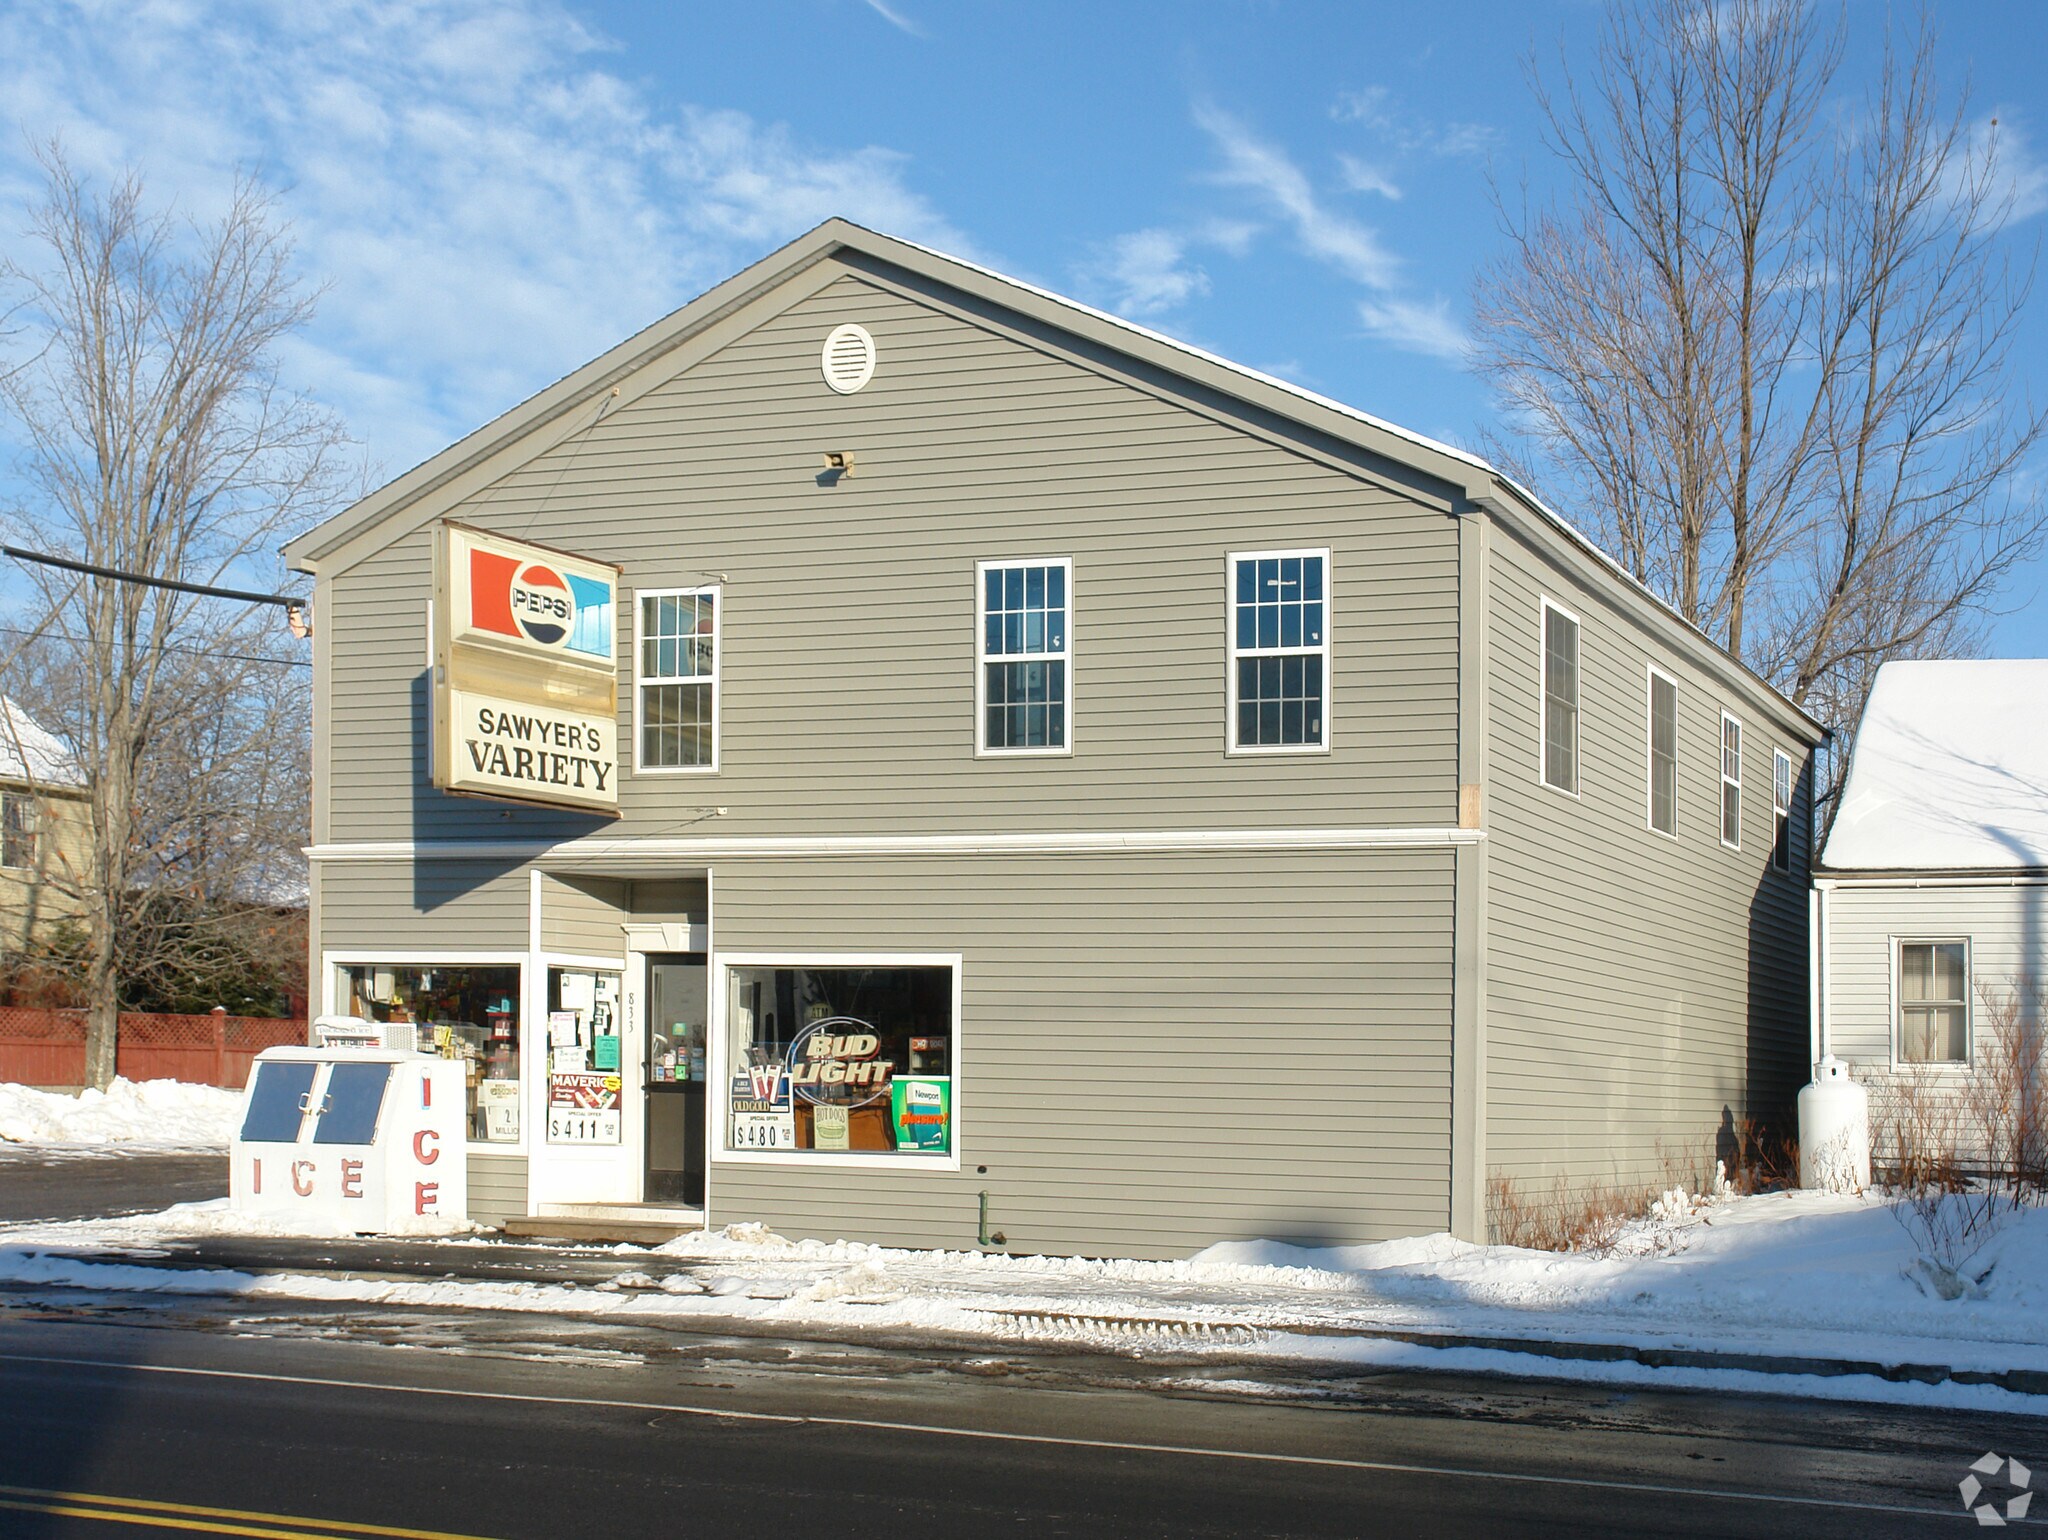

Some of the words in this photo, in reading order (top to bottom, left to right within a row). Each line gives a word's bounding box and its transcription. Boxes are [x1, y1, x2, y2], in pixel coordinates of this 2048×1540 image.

[512, 588, 572, 621] PEPSI
[478, 707, 601, 753] SAWYER'S
[465, 739, 613, 792] VARIETY
[811, 1007, 829, 1018] ATM
[806, 1034, 880, 1060] BUD
[551, 1074, 608, 1089] MAVERIC
[792, 1061, 896, 1086] LIGHT
[733, 1100, 748, 1111] OLD
[749, 1100, 770, 1111] GOLD
[915, 1089, 939, 1100] Newport
[816, 1107, 828, 1123] HOT
[829, 1107, 846, 1124] DOGS
[412, 1066, 440, 1216] ICE
[495, 1126, 519, 1135] MILLIO
[253, 1158, 364, 1199] ICE
